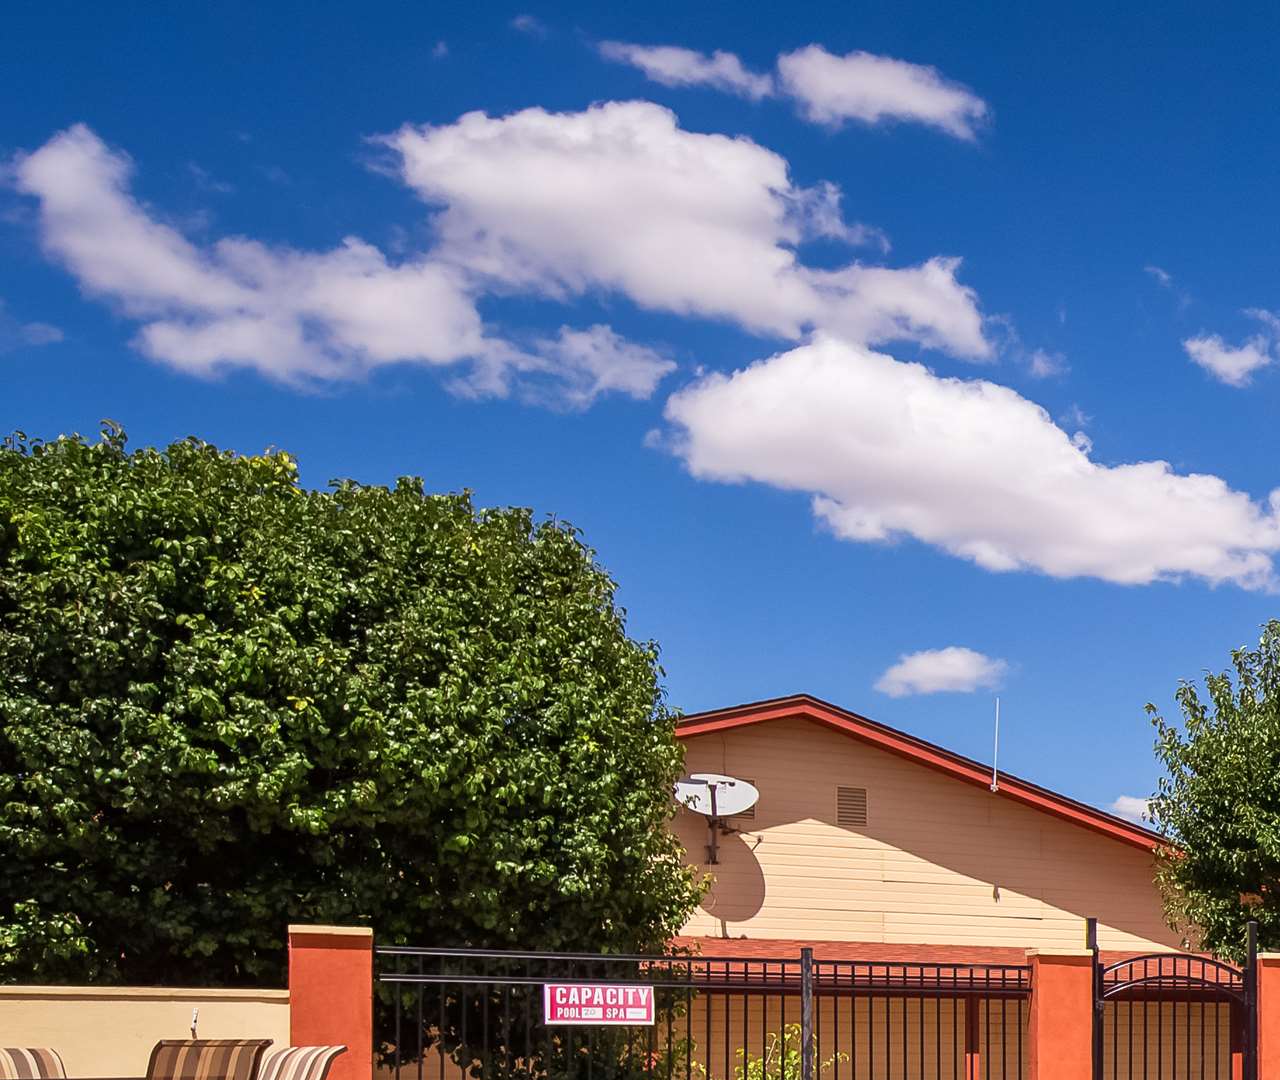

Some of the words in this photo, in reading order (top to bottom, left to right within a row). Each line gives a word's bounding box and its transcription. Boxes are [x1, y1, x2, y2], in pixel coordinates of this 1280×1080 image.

[556, 988, 649, 1005] CAPACITY
[557, 1008, 581, 1018] POOL
[606, 1008, 625, 1018] SPA
